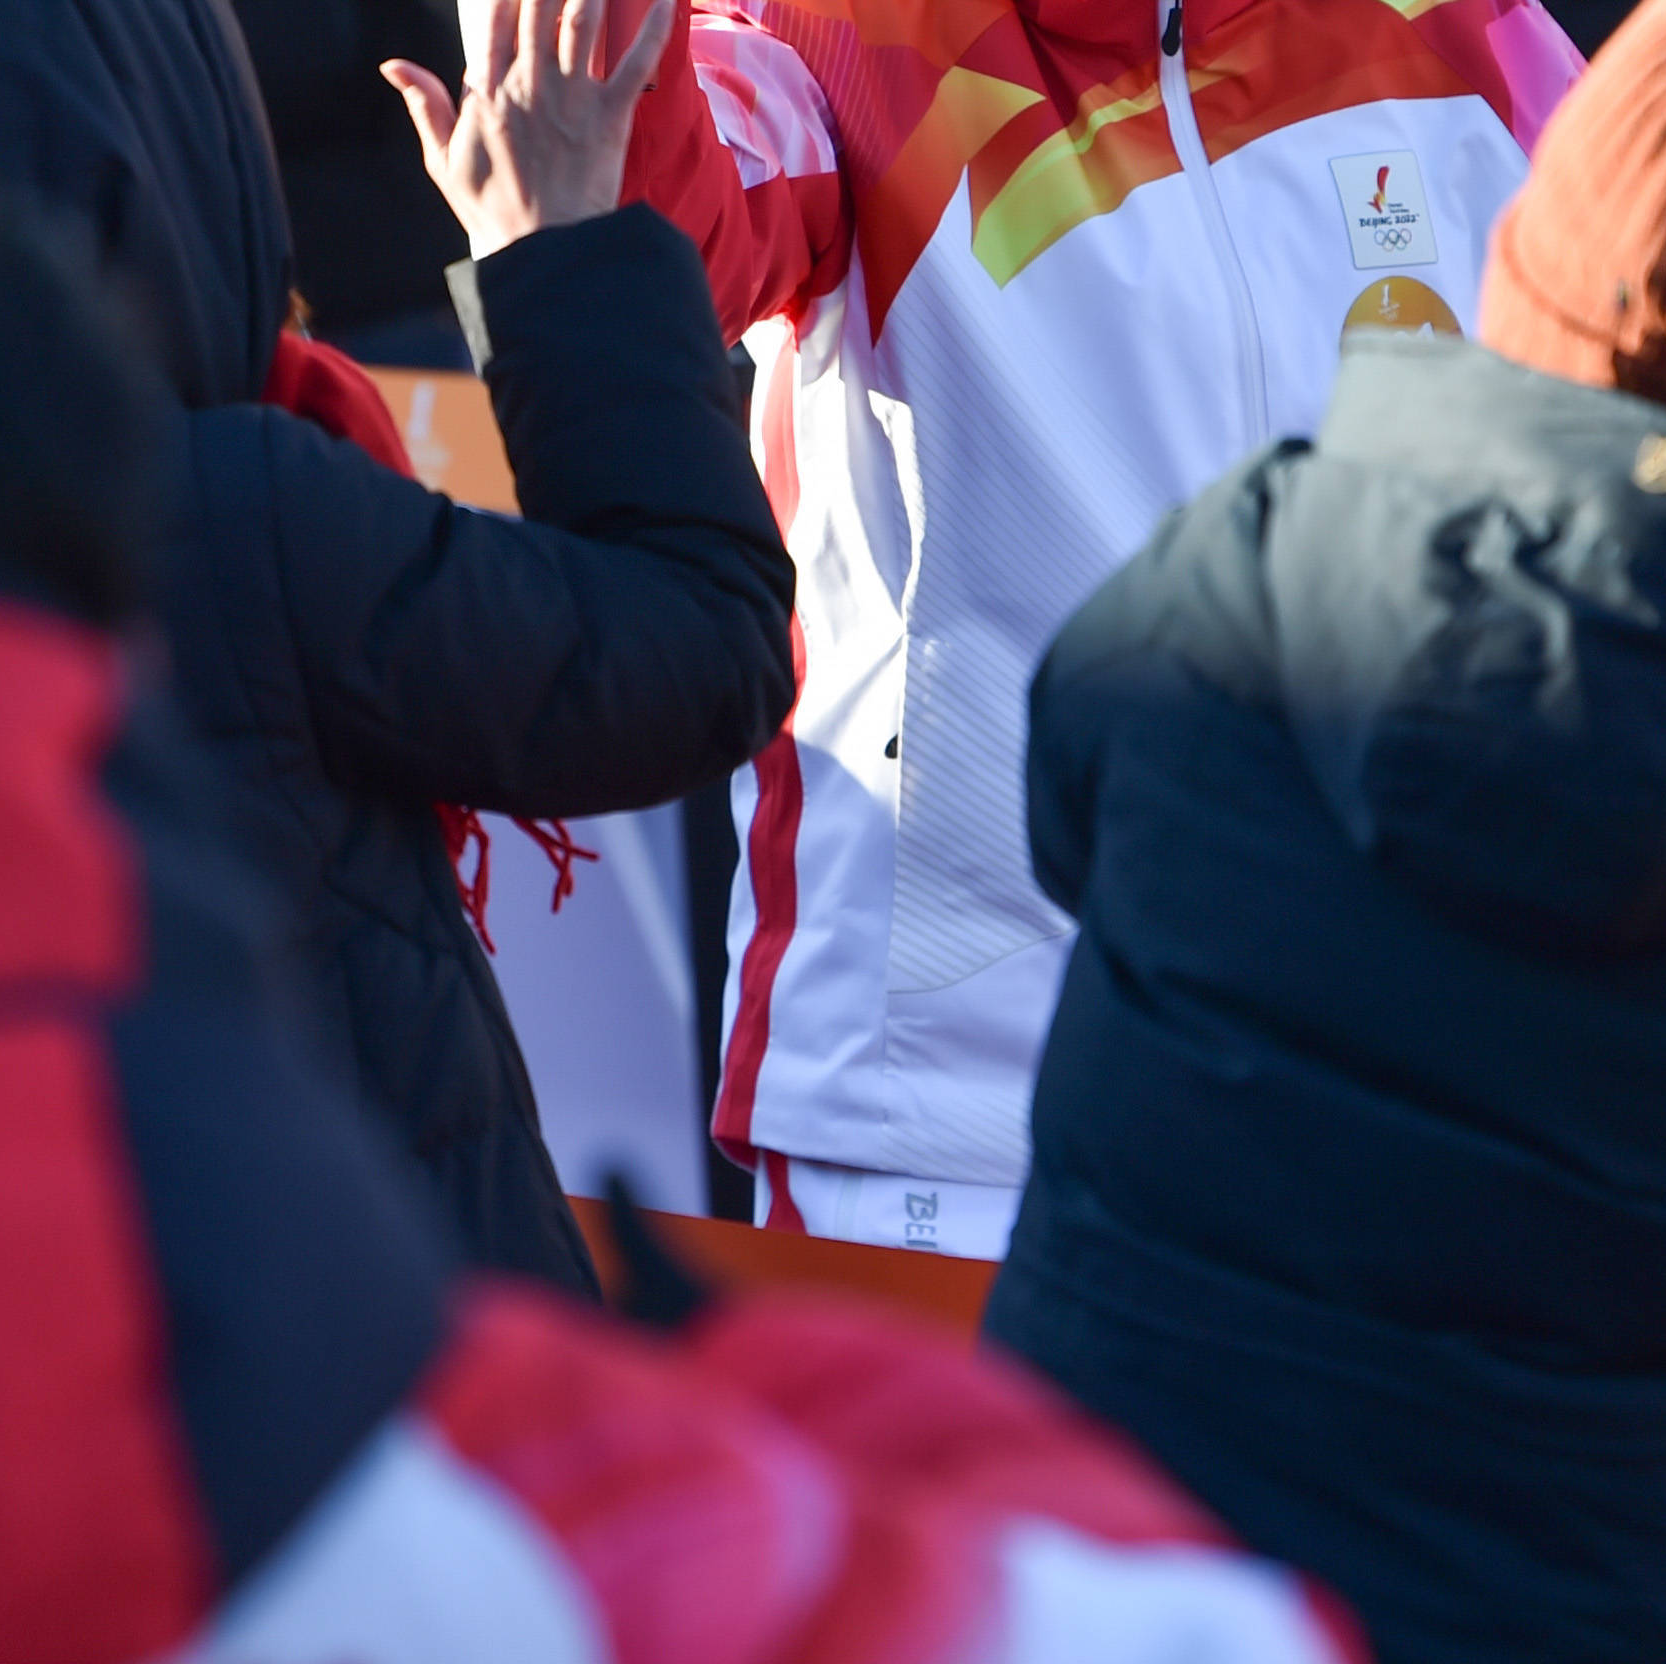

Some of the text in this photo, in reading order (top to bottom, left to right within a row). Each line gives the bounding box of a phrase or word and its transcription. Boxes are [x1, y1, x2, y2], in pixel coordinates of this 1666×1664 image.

[1359, 214, 1416, 228] BEIJING 2022
[905, 1191, 938, 1249] BEI
